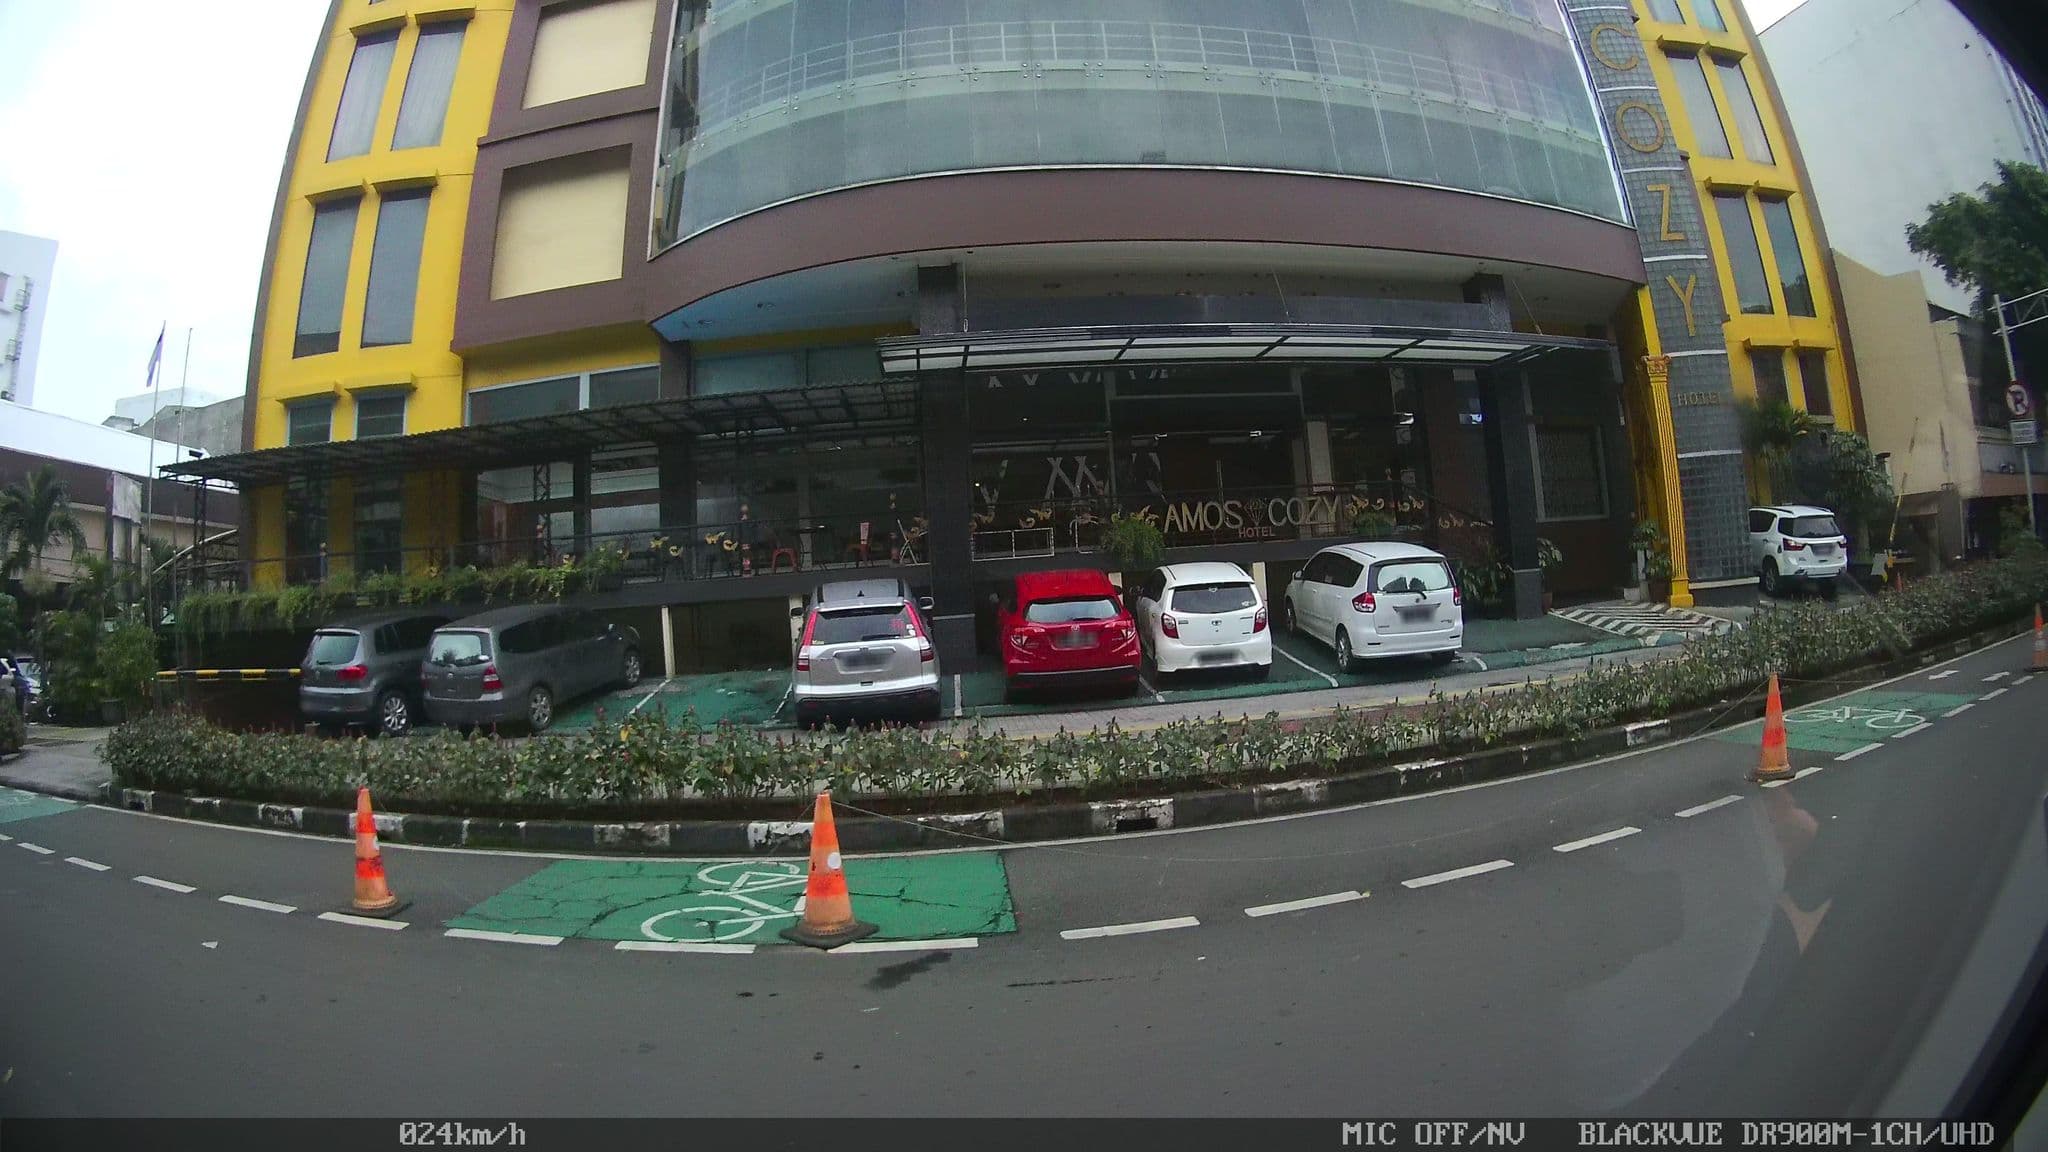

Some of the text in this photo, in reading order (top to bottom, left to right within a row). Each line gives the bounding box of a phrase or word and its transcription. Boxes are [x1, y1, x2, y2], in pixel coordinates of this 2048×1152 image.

[1591, 23, 1697, 337] COZY
[1164, 495, 1342, 533] AMOS COZY
[1238, 525, 1276, 539] HOTEL
